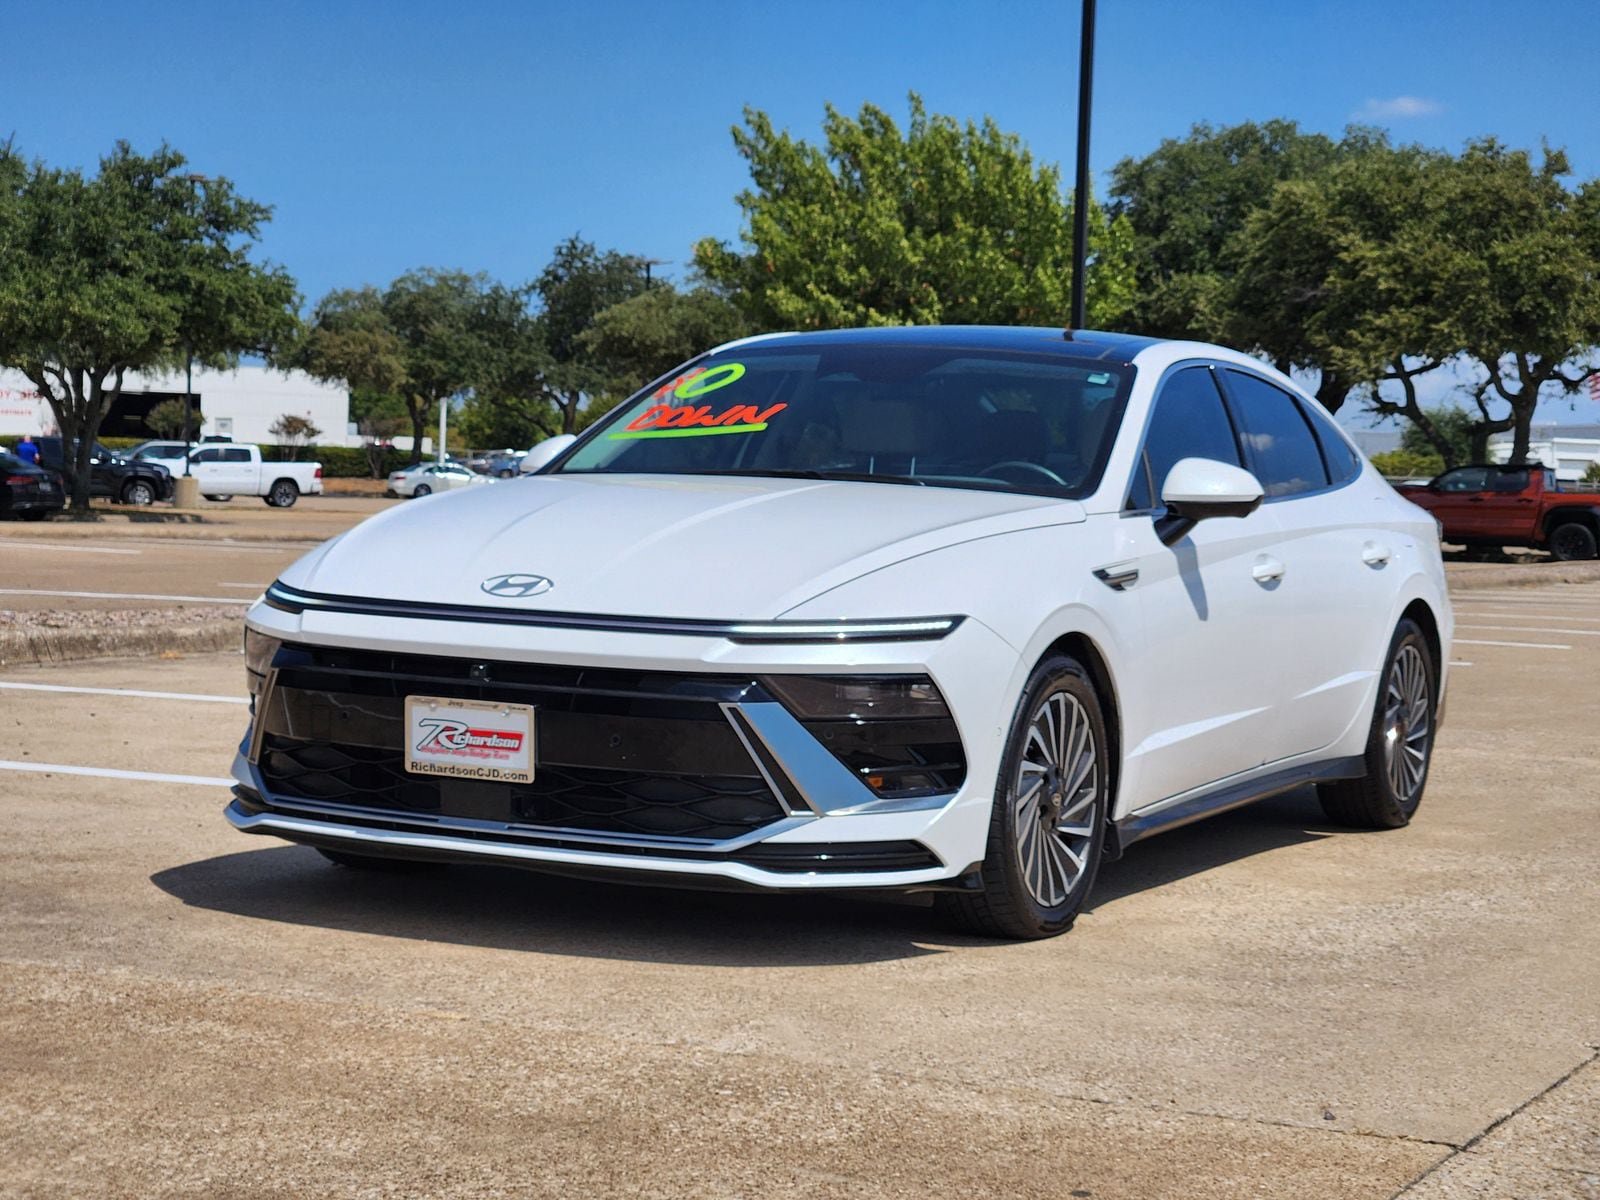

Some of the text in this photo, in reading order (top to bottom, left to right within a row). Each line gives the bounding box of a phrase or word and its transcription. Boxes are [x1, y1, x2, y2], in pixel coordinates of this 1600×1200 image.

[625, 402, 788, 432] DOWN
[416, 718, 520, 751] Richardson
[410, 761, 528, 781] RichardsonCJD.com
